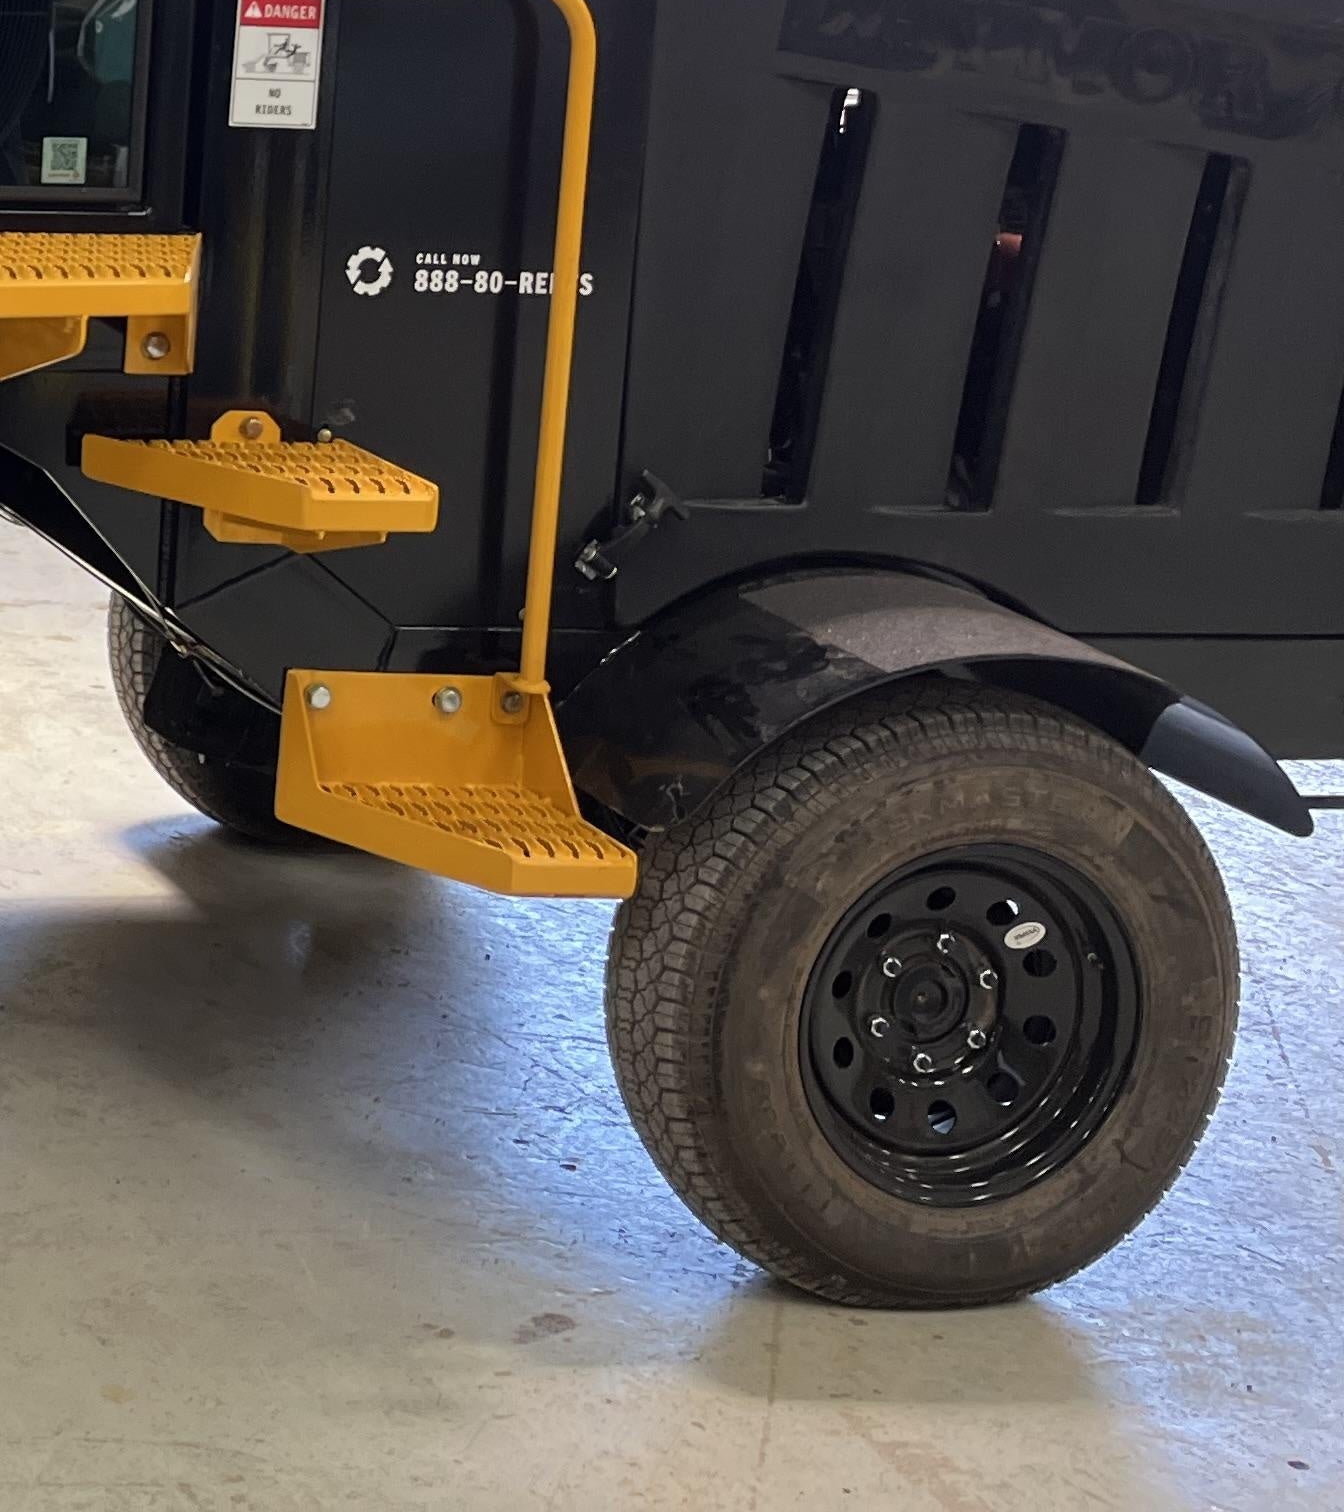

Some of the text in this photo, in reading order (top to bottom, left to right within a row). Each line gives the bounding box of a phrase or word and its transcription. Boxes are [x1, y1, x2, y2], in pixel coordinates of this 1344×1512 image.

[264, 3, 317, 20] DANGER
[268, 88, 282, 99] NO
[255, 104, 292, 116] RIDERS
[415, 253, 481, 265] CALL NOW
[413, 269, 595, 296] 888-80-RES
